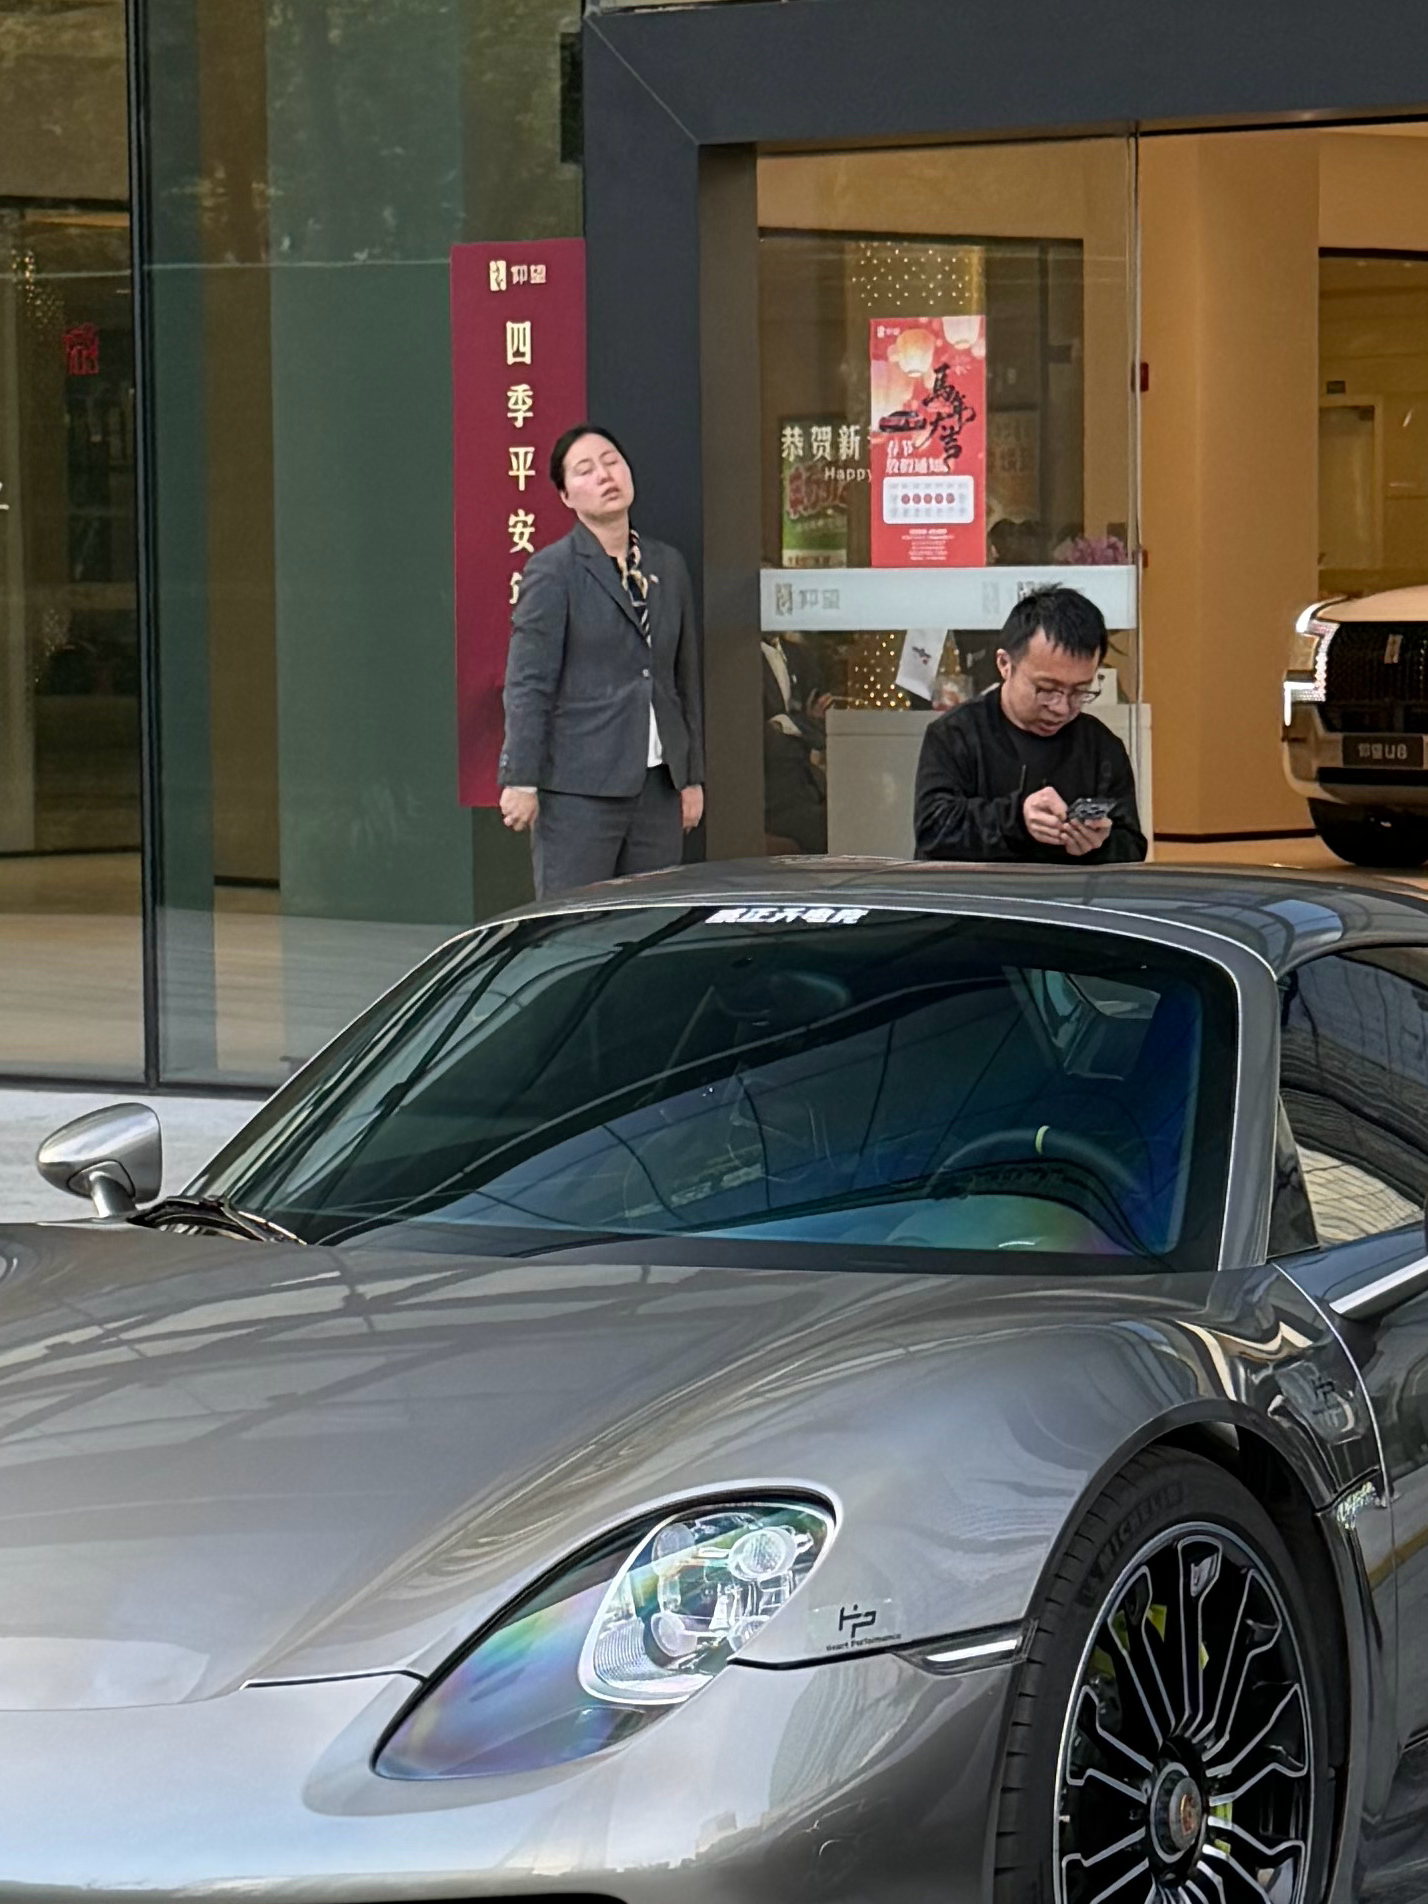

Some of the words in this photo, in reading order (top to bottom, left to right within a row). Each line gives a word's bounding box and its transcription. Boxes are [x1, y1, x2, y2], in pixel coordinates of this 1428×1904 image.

[510, 264, 547, 284] 仰望
[781, 425, 872, 462] 恭贺新
